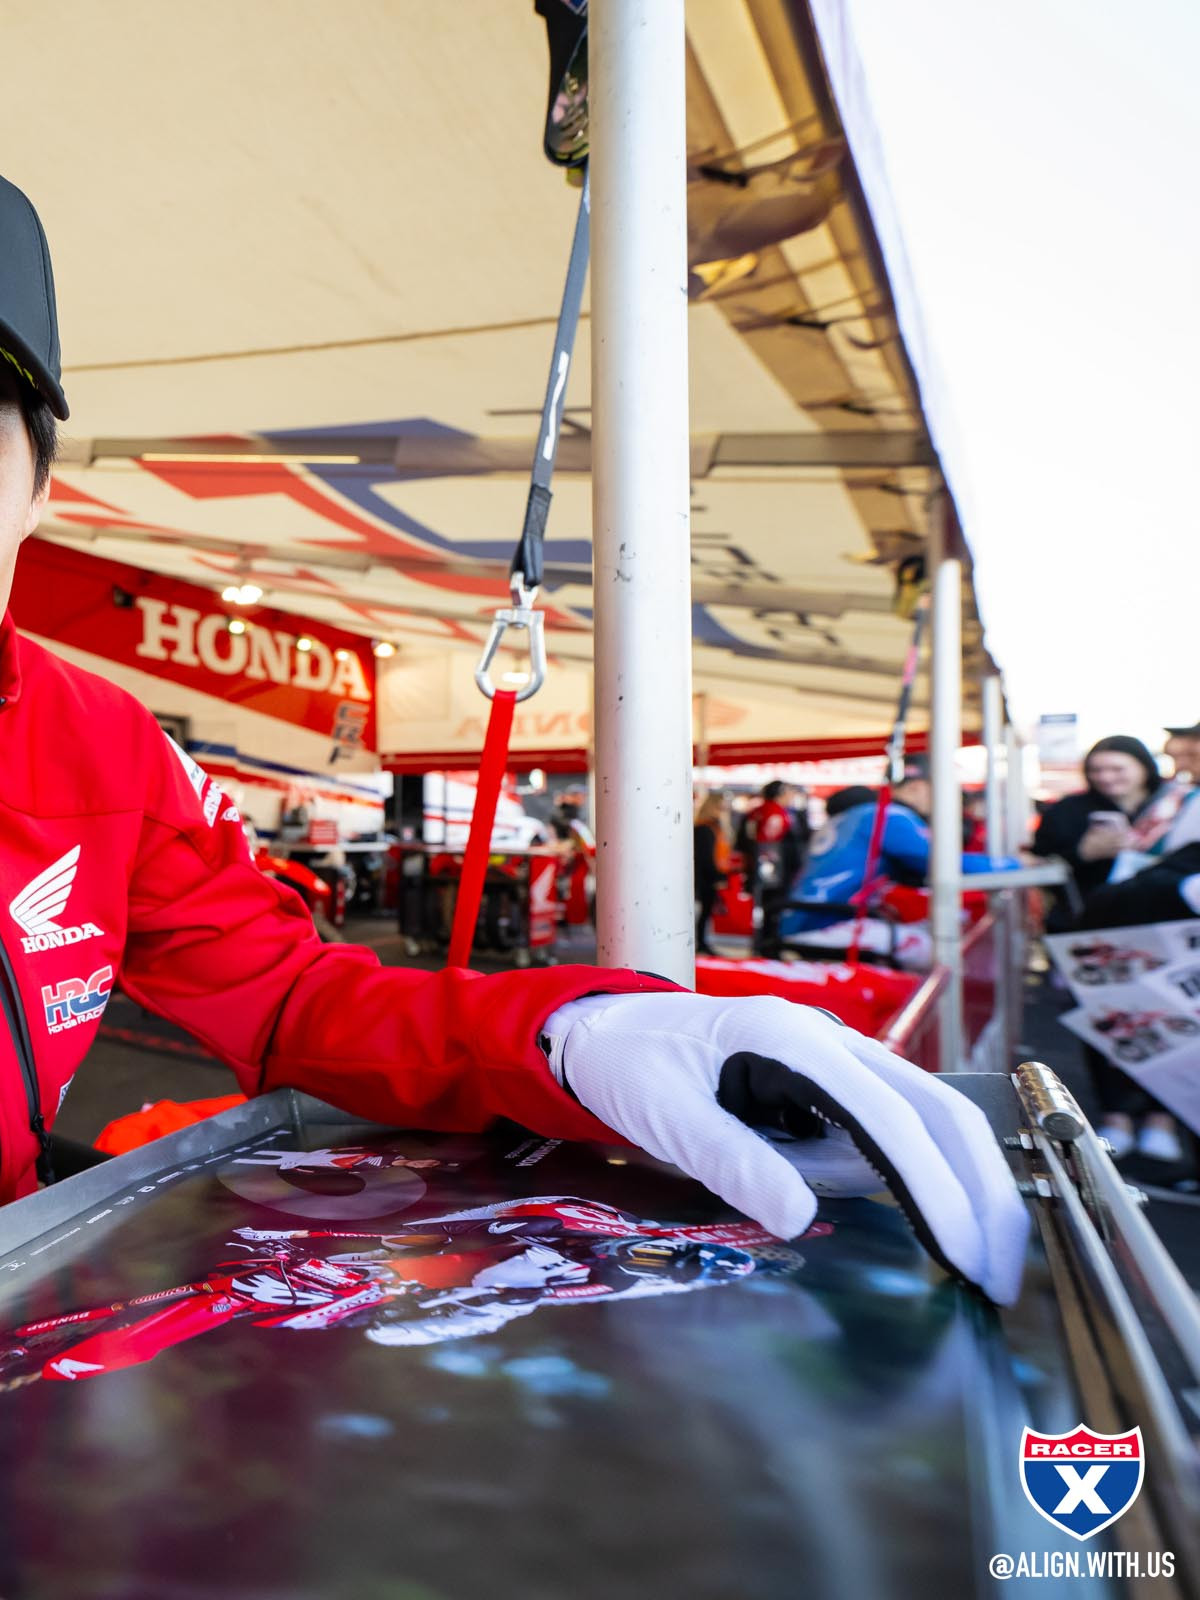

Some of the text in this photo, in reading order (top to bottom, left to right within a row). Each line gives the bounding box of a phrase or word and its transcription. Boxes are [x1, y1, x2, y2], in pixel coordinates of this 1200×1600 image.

[136, 596, 372, 700] HONDA
[20, 922, 104, 954] HONDA
[41, 965, 113, 1027] HRC
[26, 1311, 91, 1332] DUNLOP
